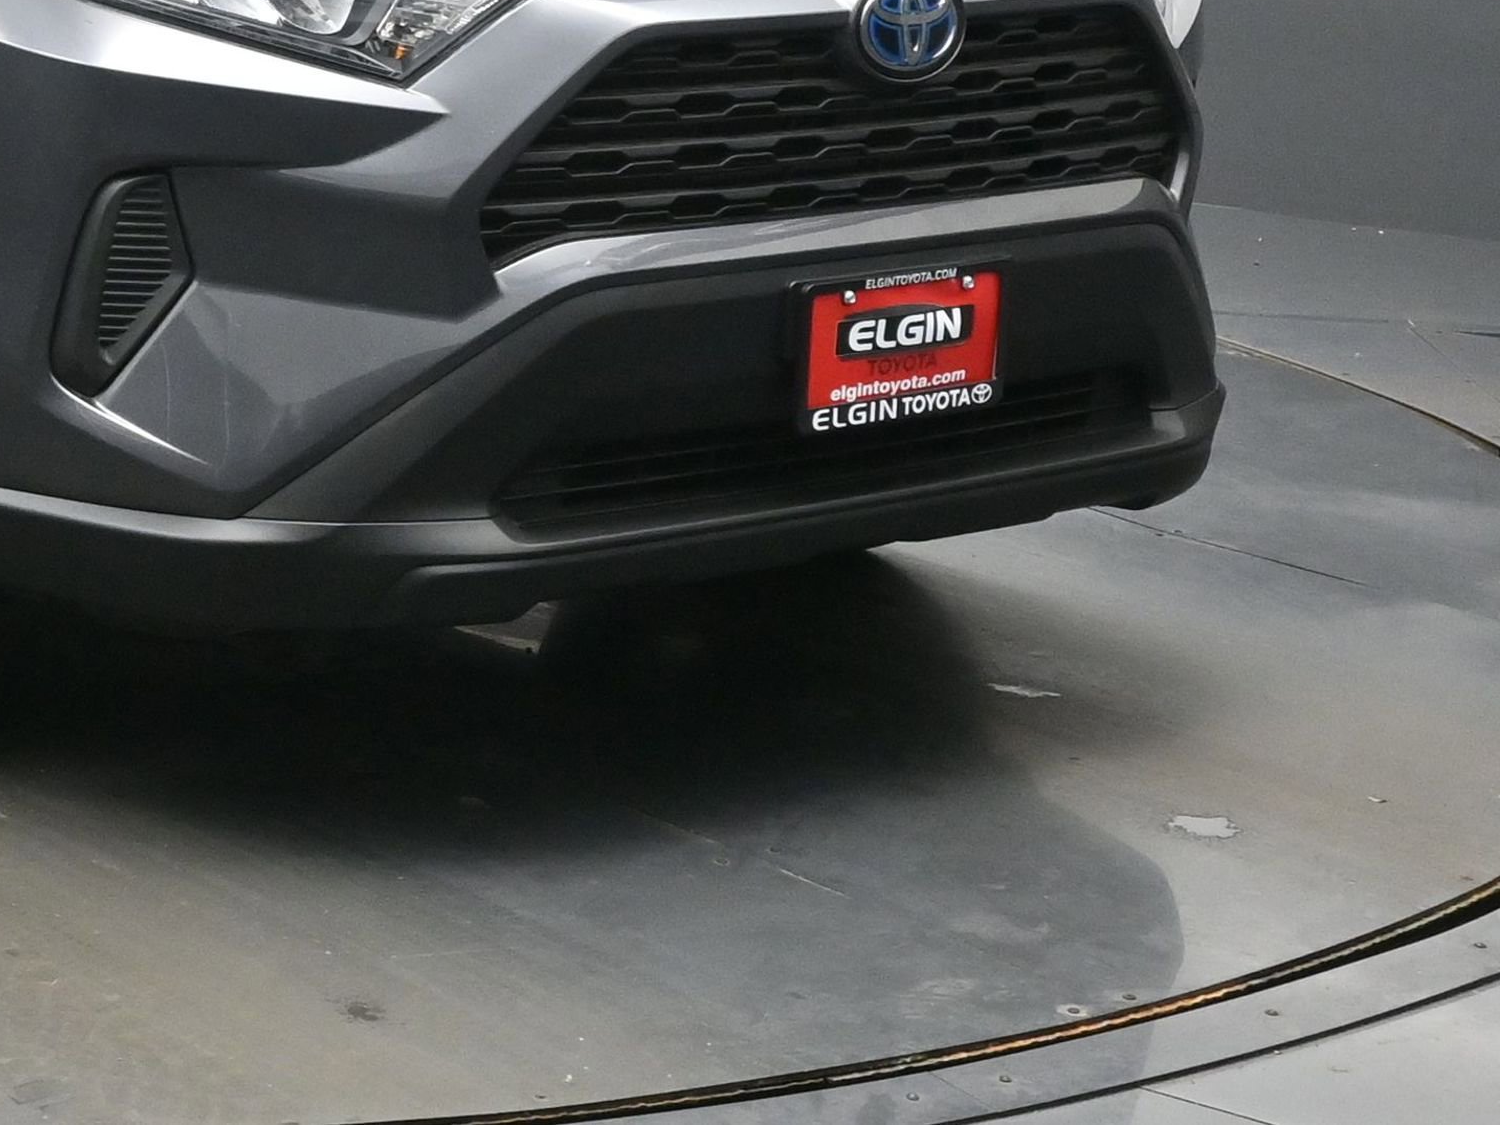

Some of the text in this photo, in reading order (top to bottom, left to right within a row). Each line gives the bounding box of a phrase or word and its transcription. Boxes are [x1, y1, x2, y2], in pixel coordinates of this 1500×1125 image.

[865, 268, 958, 290] ELGINTOYOTA.COM
[848, 307, 962, 353] ELGIN
[868, 352, 938, 376] TOYOTA
[830, 369, 967, 403] elgintoyota.com
[812, 388, 971, 431] ELGIN TOYOTA
